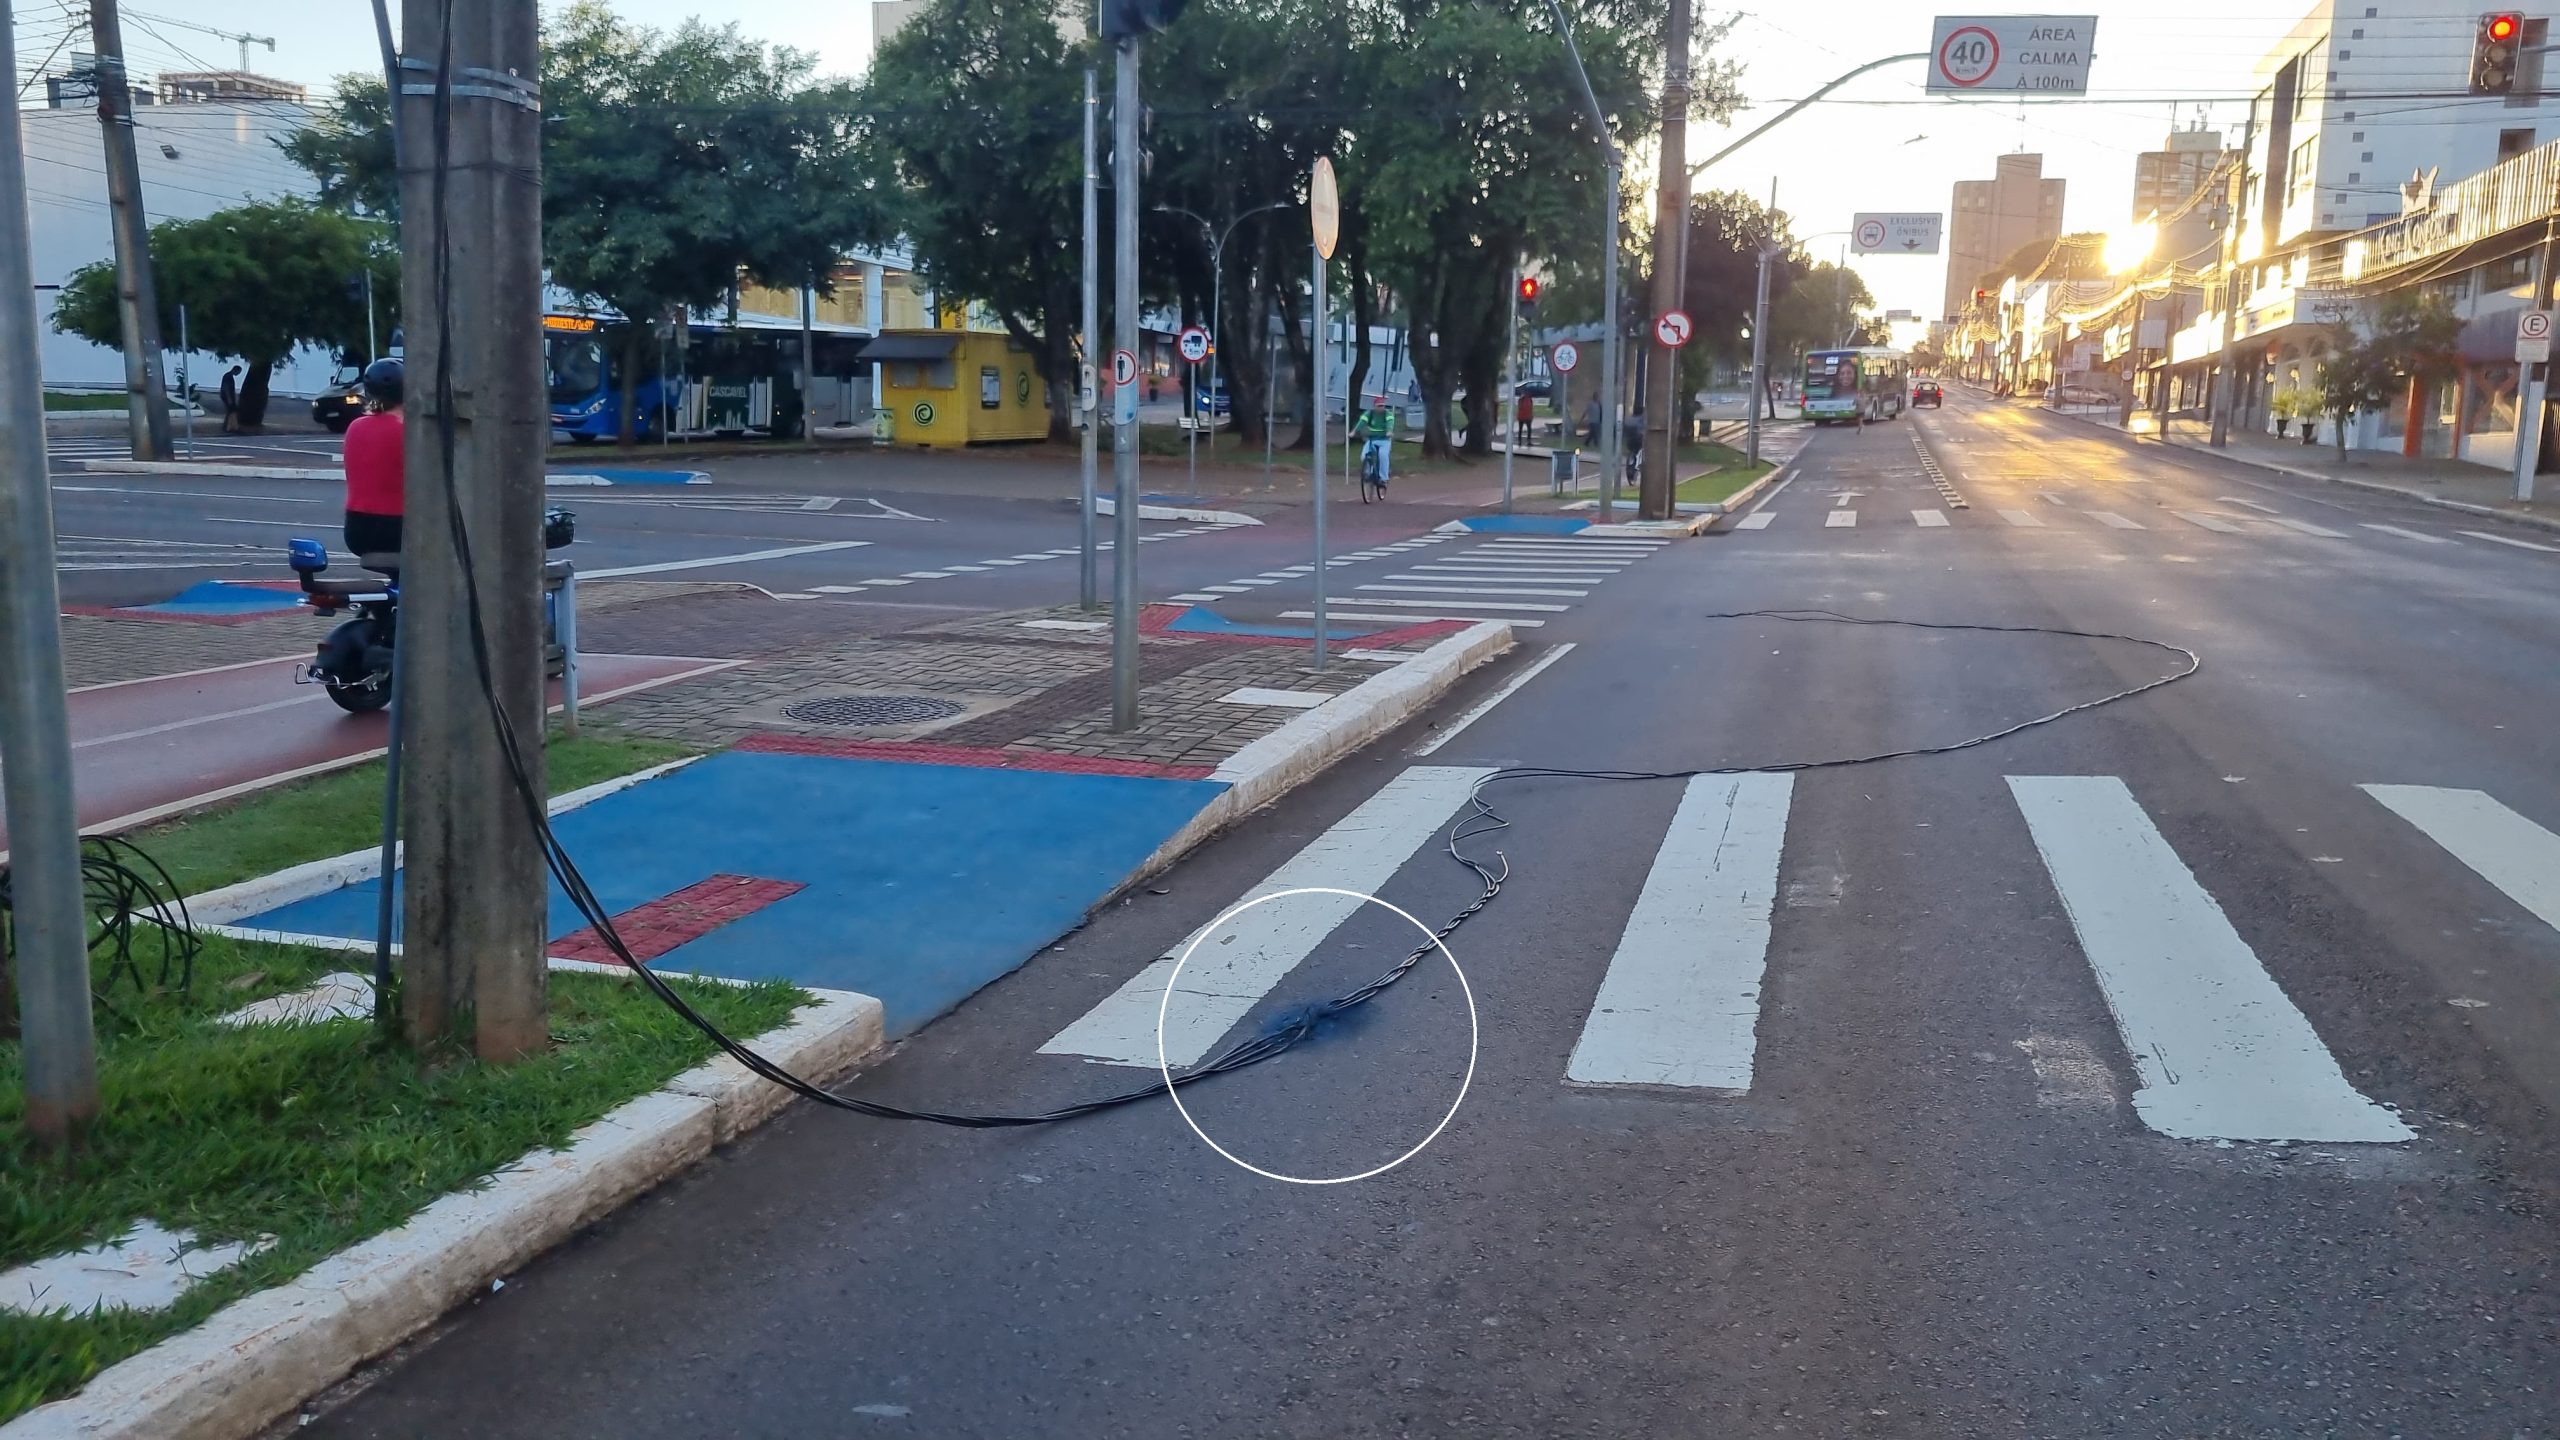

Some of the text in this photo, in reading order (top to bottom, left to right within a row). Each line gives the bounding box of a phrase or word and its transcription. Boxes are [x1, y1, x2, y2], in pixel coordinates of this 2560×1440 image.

[2029, 25, 2076, 42] ÁREA
[1951, 41, 1986, 65] 40
[2019, 52, 2079, 66] CALMA
[2035, 76, 2074, 89] 100m
[1890, 216, 1938, 226] EXCLUSIVO
[2530, 318, 2541, 332] E
[709, 386, 747, 398] CASCAVEL
